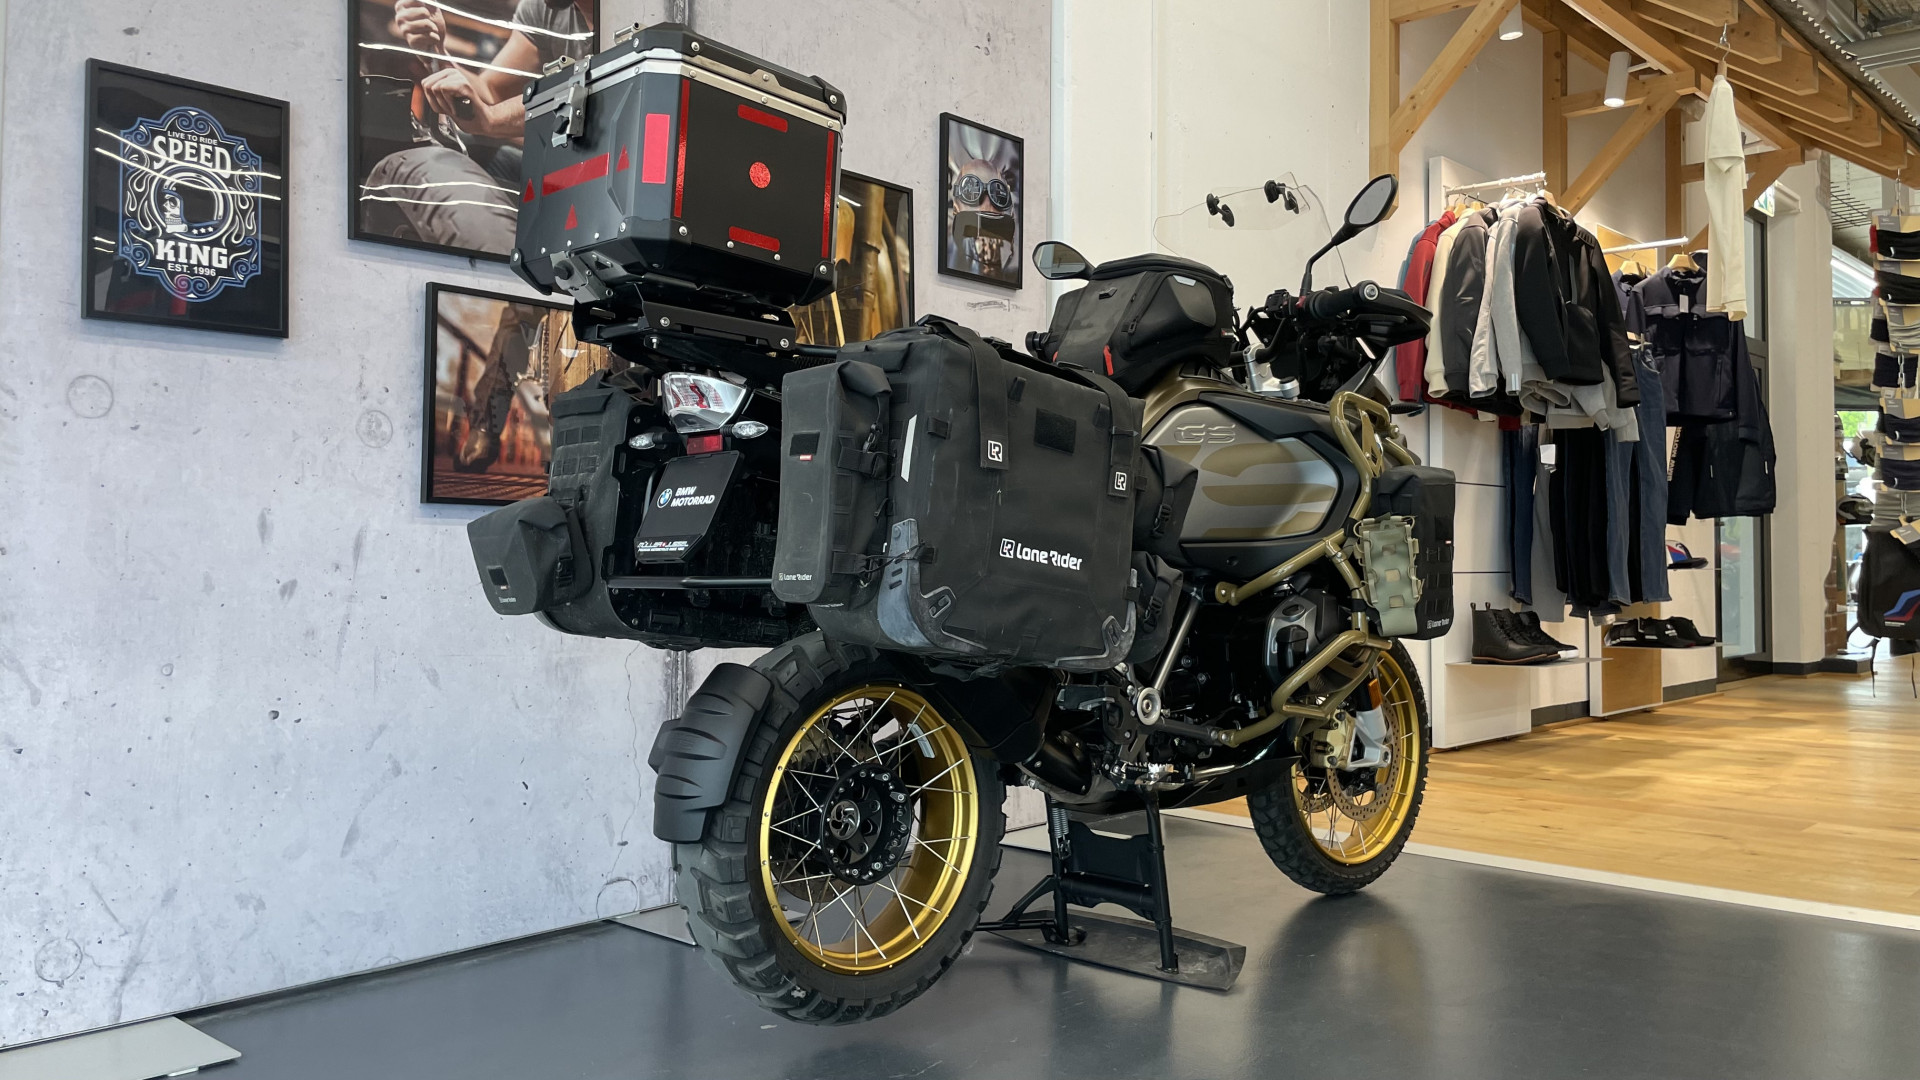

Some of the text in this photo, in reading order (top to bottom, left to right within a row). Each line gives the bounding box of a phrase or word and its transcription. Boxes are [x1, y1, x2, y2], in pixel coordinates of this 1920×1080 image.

[167, 130, 218, 146] LIVE TO RIDE
[153, 135, 231, 179] SPEED
[156, 238, 228, 269] KING
[167, 262, 216, 277] EST. 1996
[1174, 423, 1236, 444] GS
[670, 494, 715, 507] MOTORRAD
[675, 486, 697, 497] BMW
[1016, 543, 1049, 565] Lone
[1049, 550, 1083, 571] Rider
